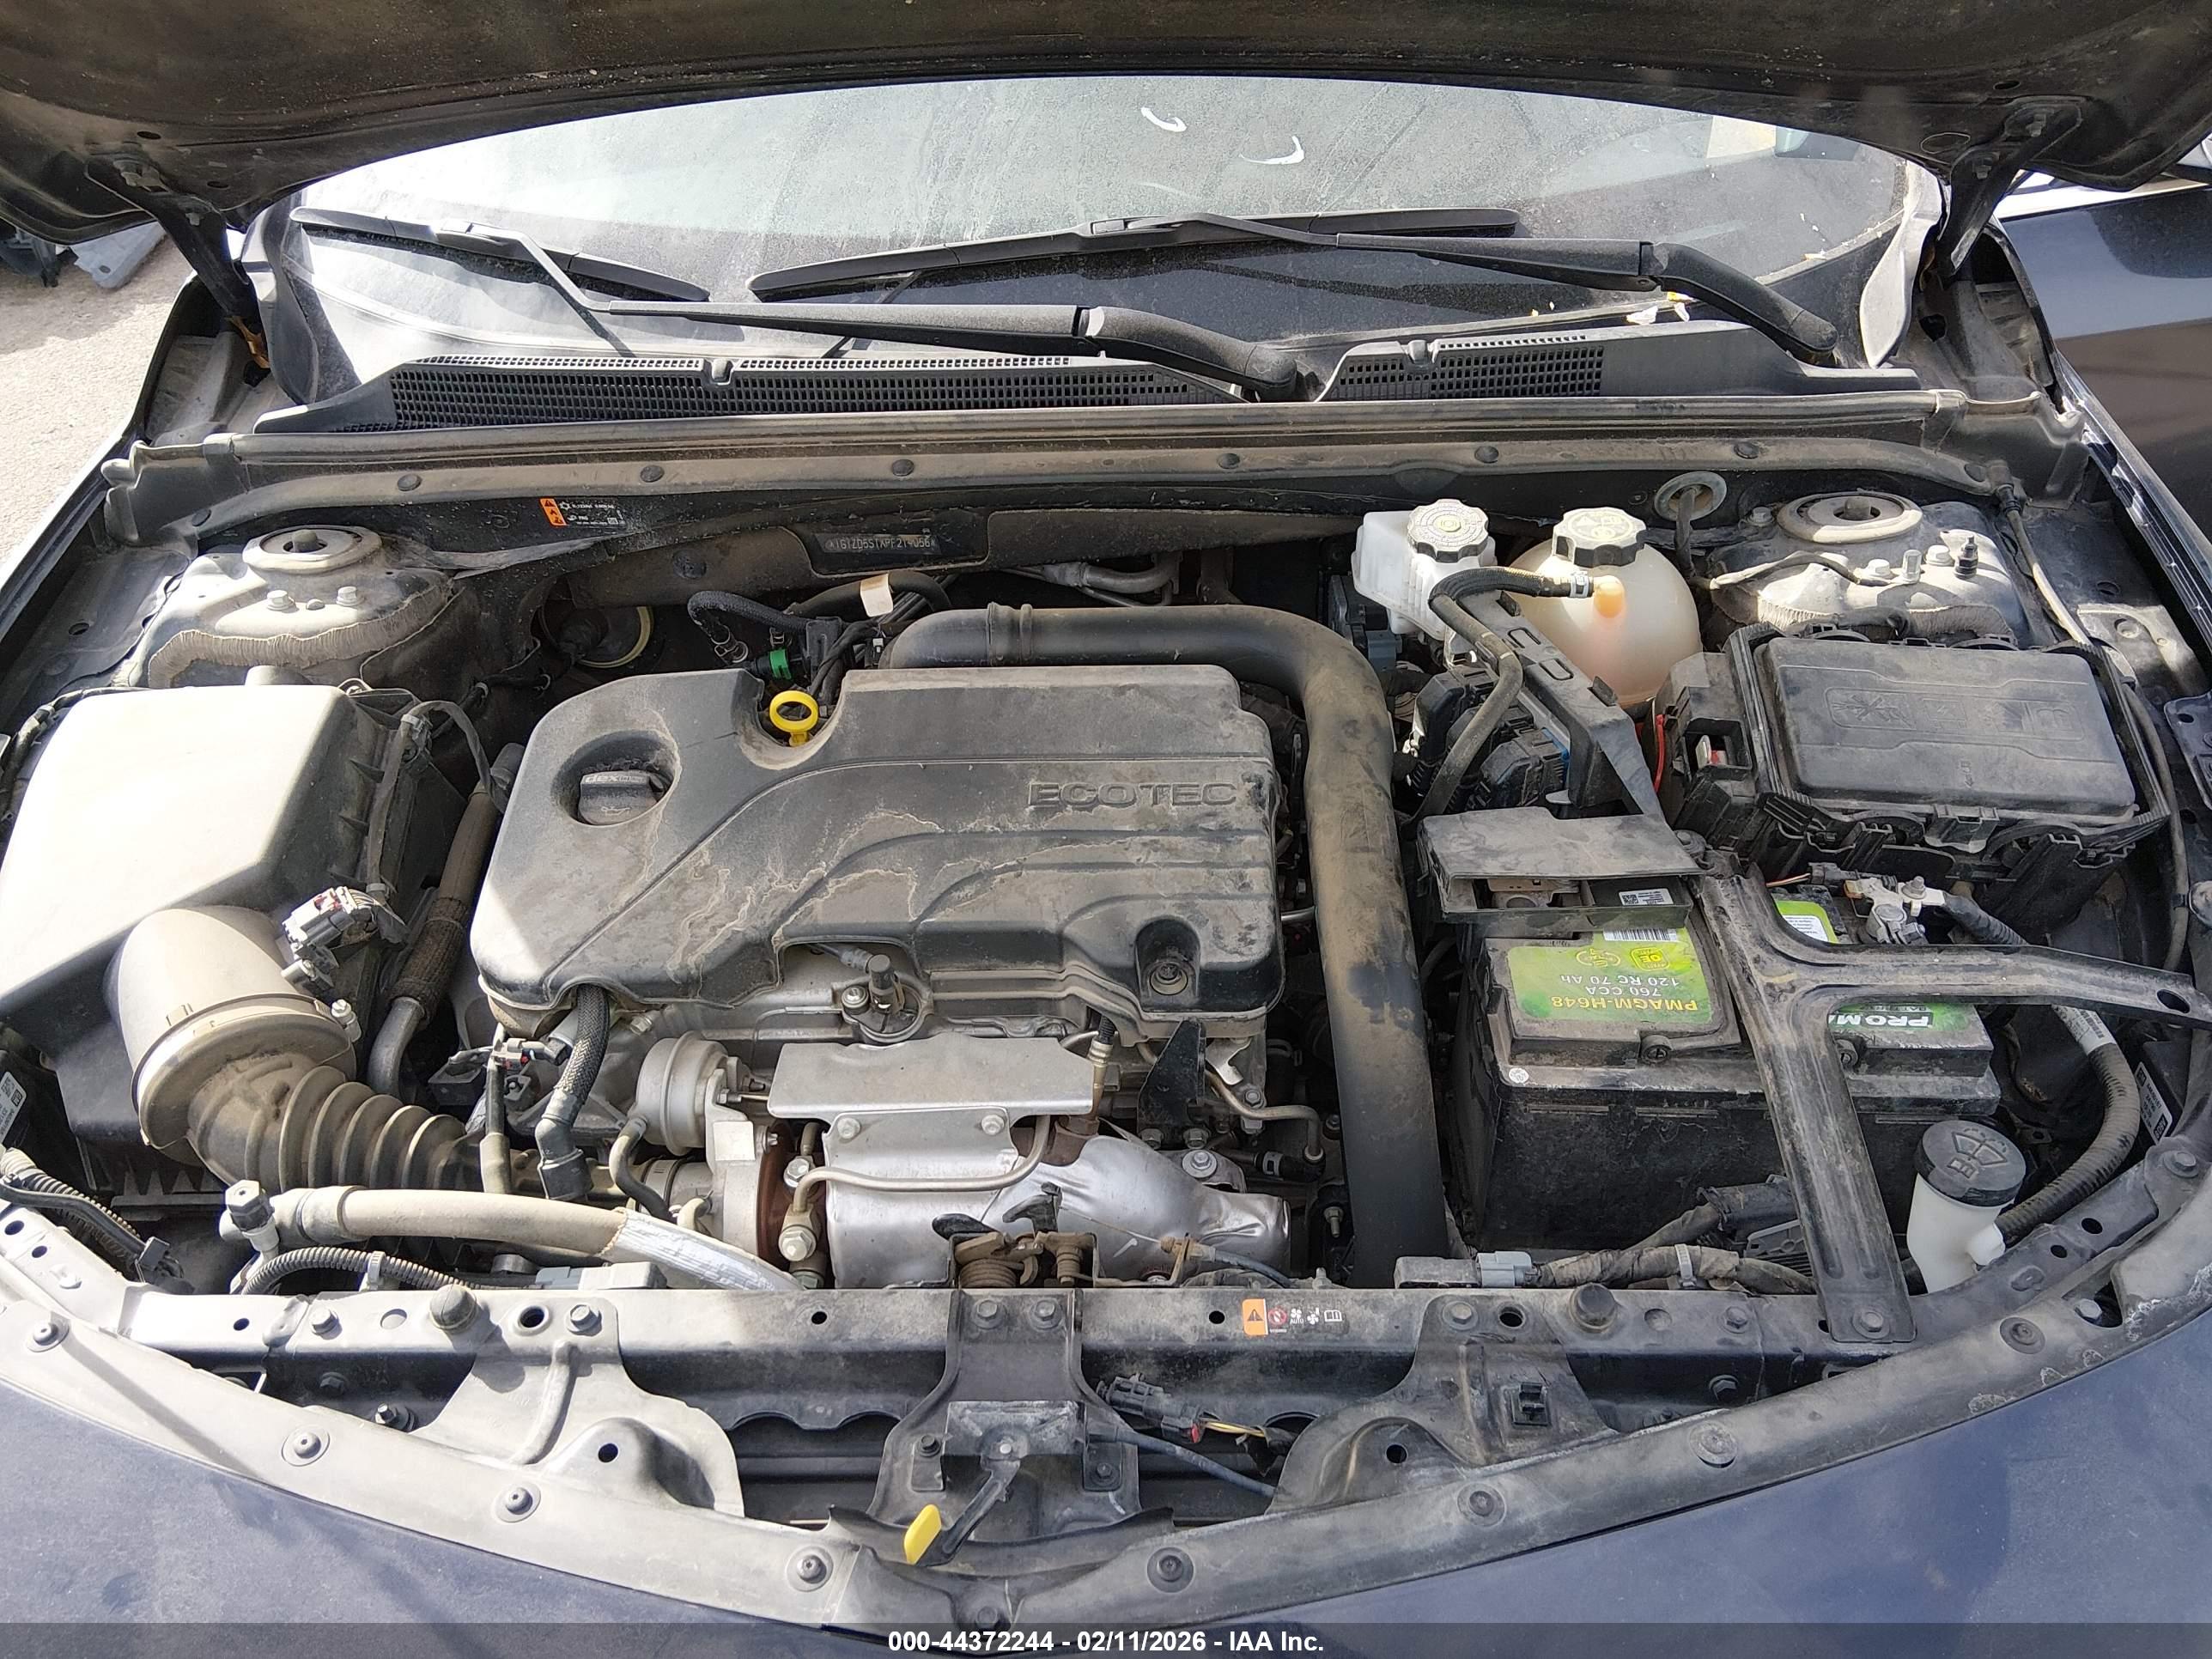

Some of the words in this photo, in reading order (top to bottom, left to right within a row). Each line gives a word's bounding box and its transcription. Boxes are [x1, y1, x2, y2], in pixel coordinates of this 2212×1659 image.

[1028, 782, 1237, 807] ECOTEC
[1560, 975, 1583, 984] Ah
[1590, 975, 1612, 985] 70
[1618, 975, 1642, 986] RC
[1649, 976, 1680, 987] 120
[1585, 986, 1623, 995] CCA
[1629, 988, 1662, 997] 760
[1551, 996, 1698, 1011] PMAGM-H648
